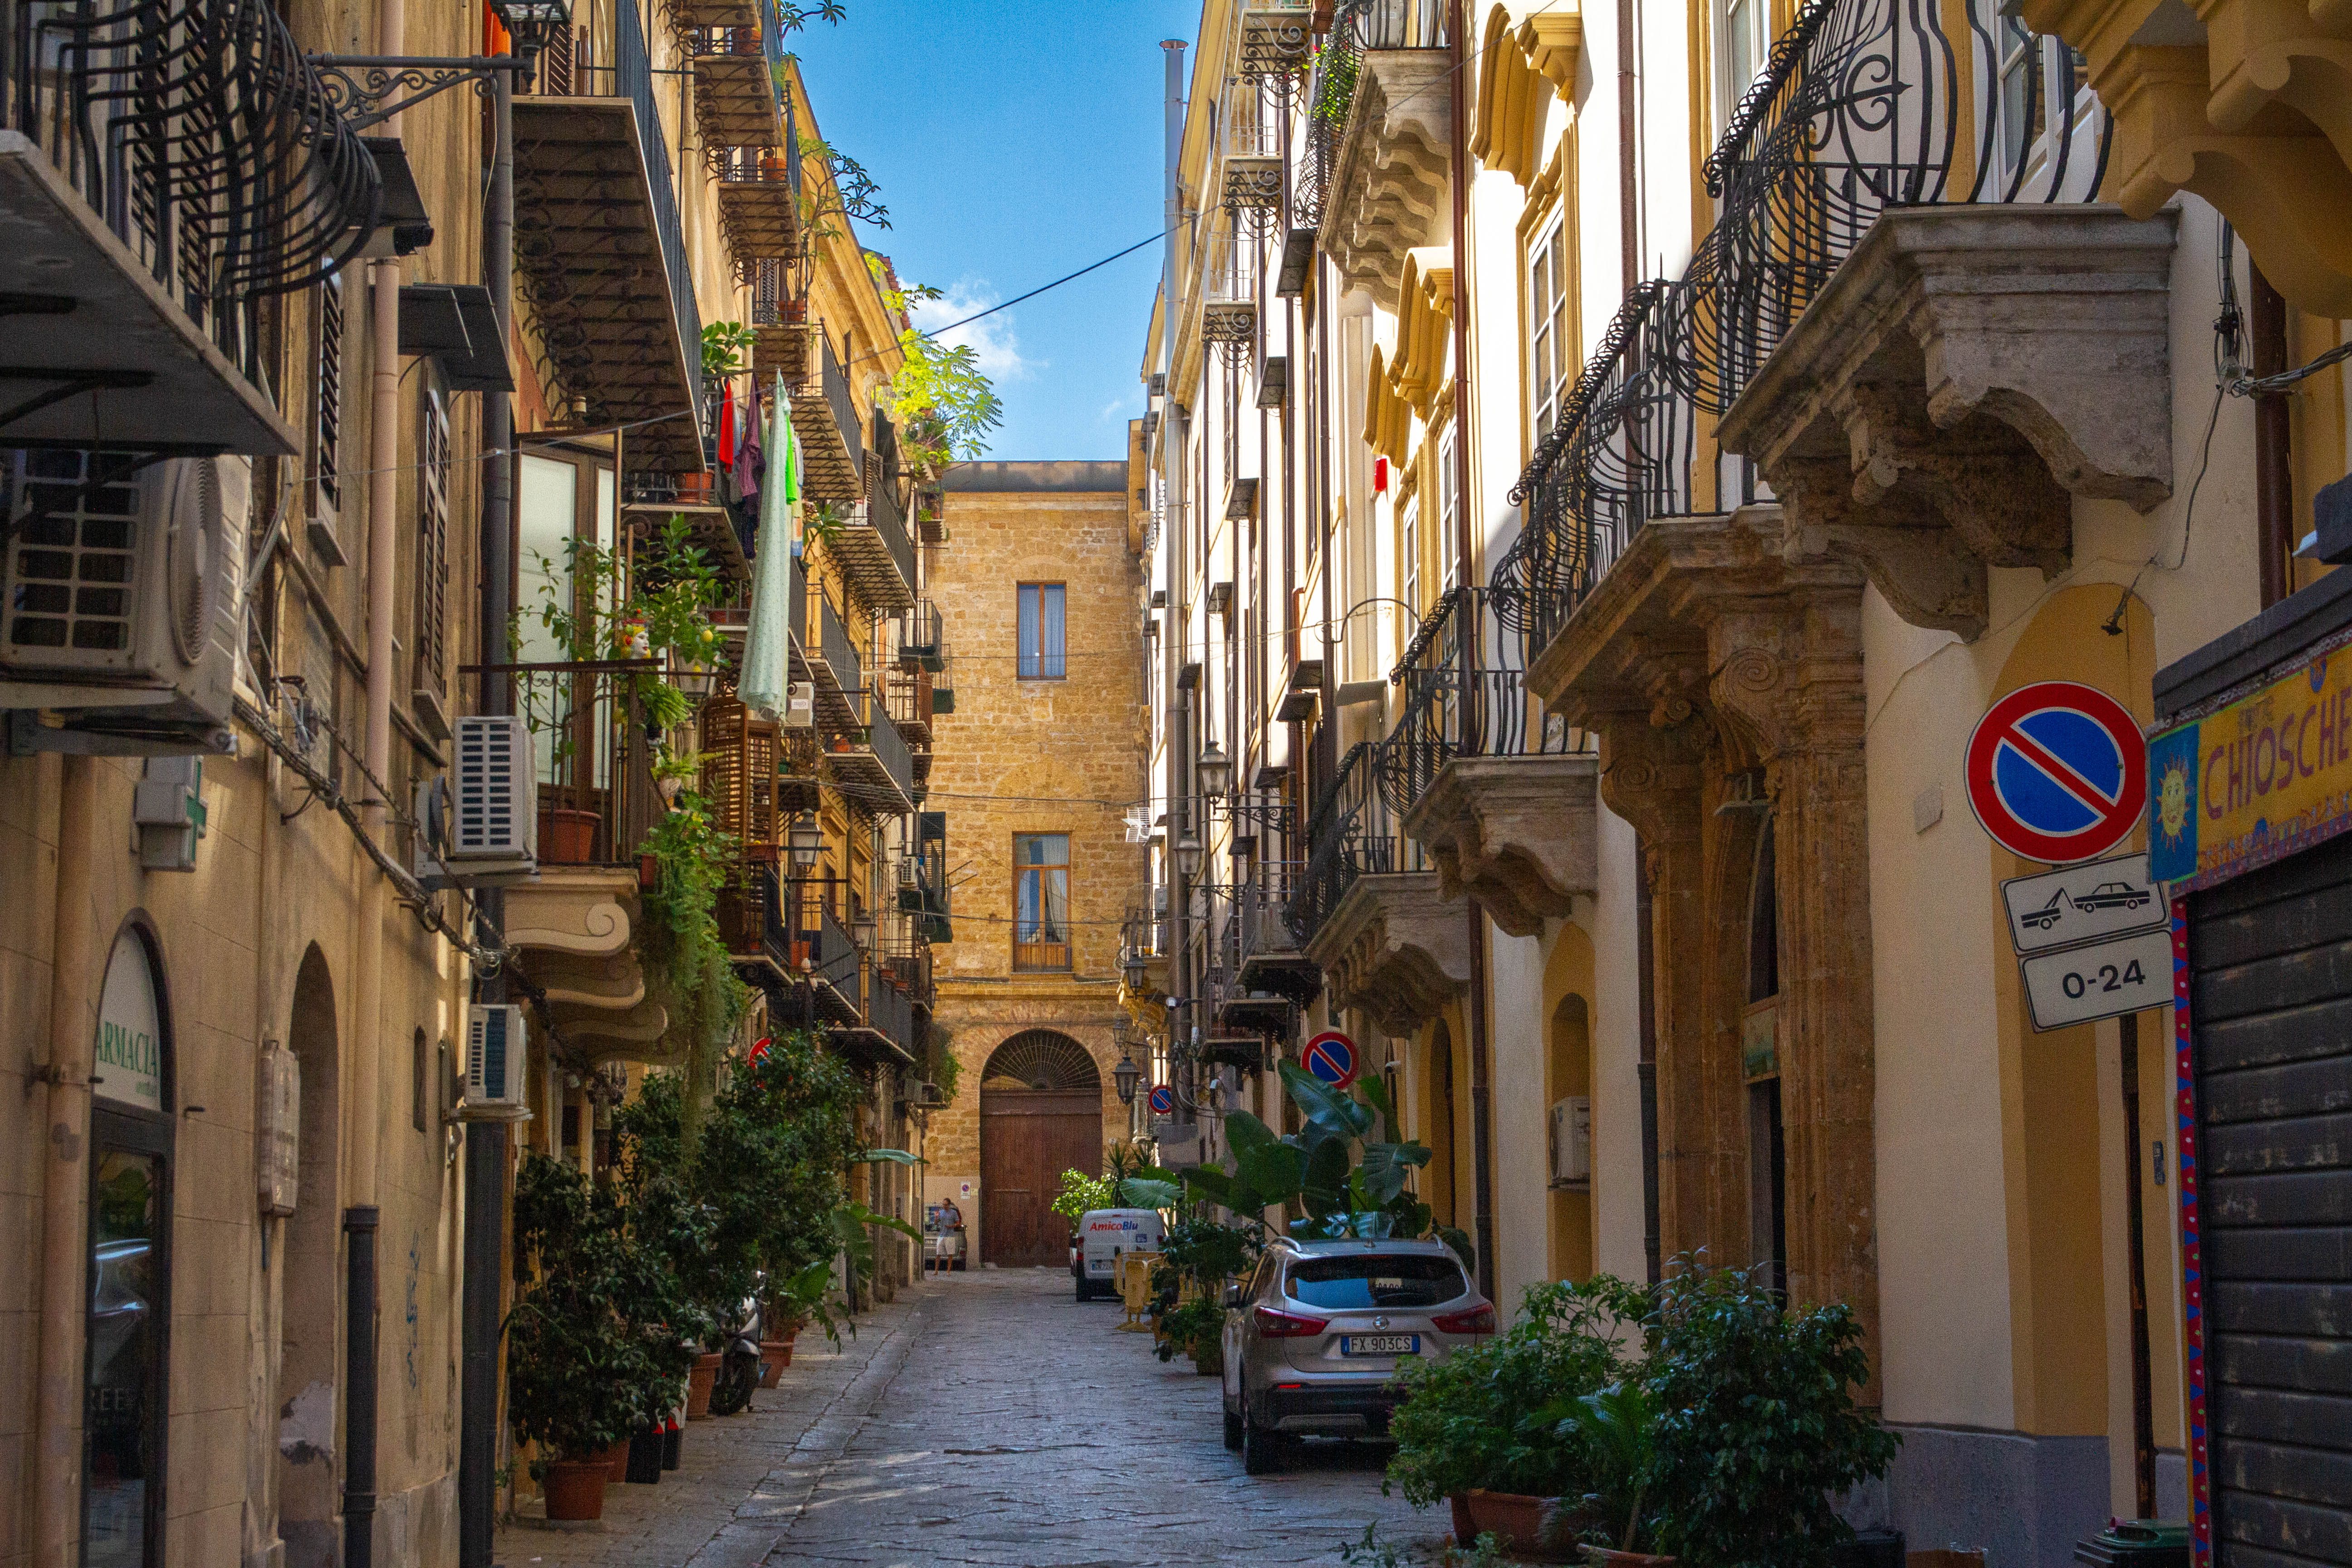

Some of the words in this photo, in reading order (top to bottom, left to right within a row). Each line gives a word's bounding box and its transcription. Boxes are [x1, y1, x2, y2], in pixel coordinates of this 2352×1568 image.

[2205, 686, 2351, 820] CHIOSCHE
[2062, 959, 2146, 999] 0-24
[1089, 1220, 1138, 1231] AmicoBlu
